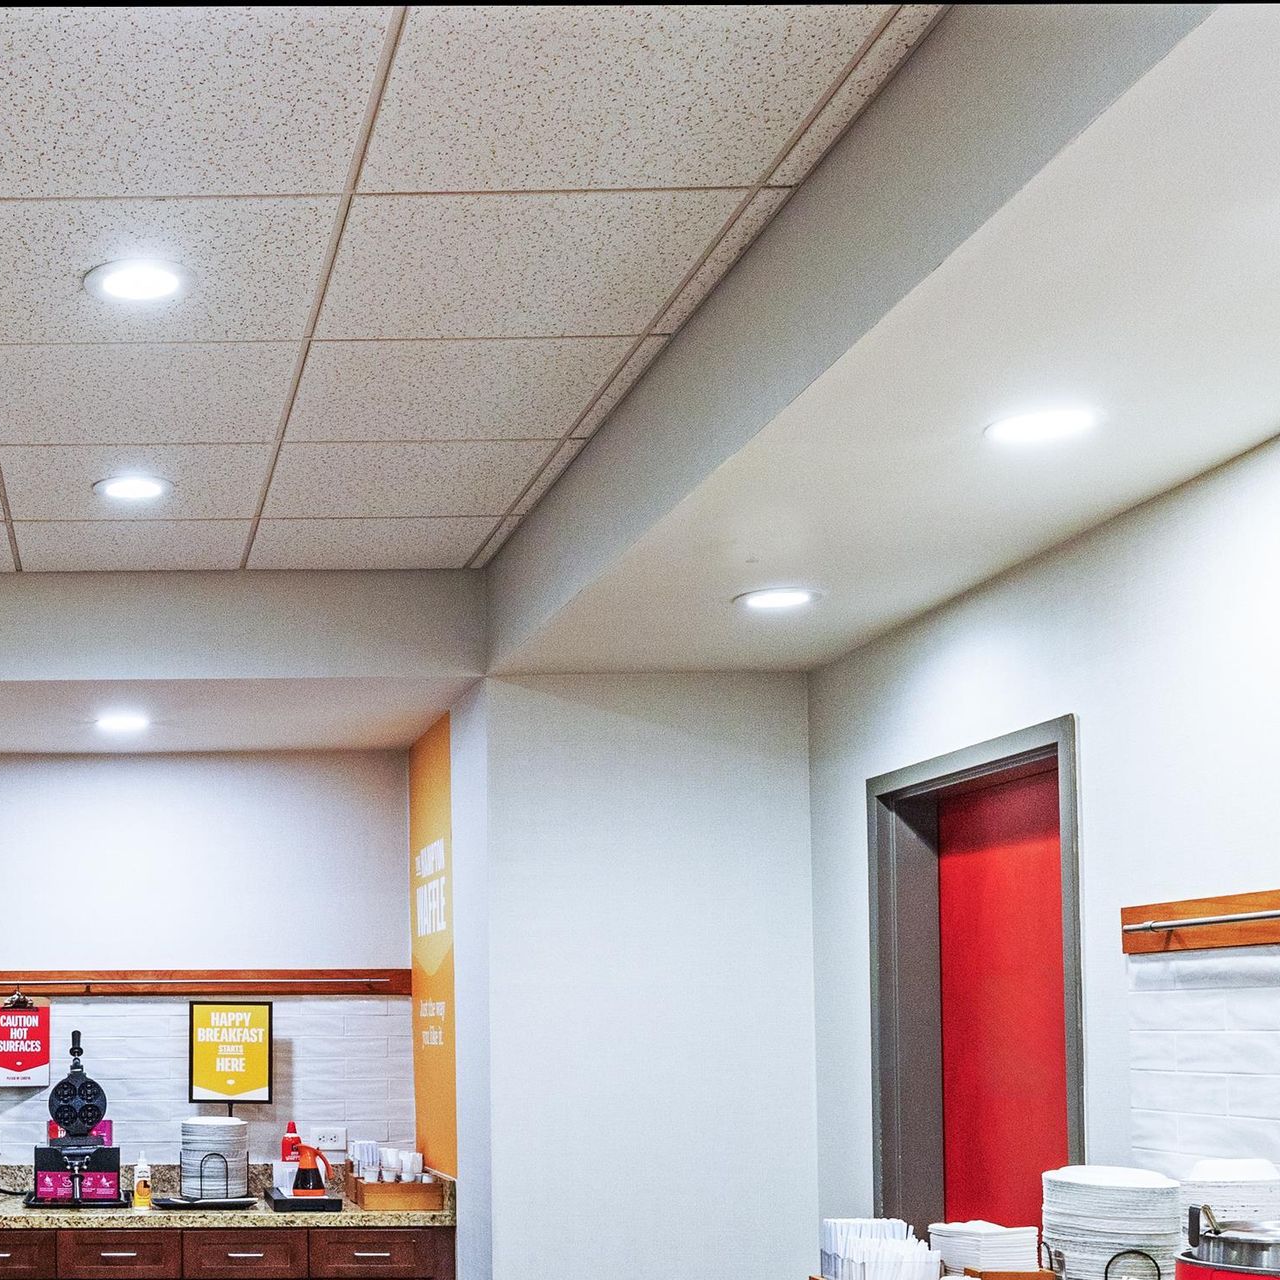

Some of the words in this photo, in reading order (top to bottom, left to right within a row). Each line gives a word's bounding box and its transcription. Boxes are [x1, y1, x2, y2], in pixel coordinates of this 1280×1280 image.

[0, 1015, 39, 1027] CAUTION
[210, 1011, 252, 1027] HAPPY
[10, 1028, 28, 1040] HOT
[197, 1027, 265, 1043] BREAKFAST
[218, 1045, 244, 1053] STARTS
[215, 1057, 246, 1072] HERE
